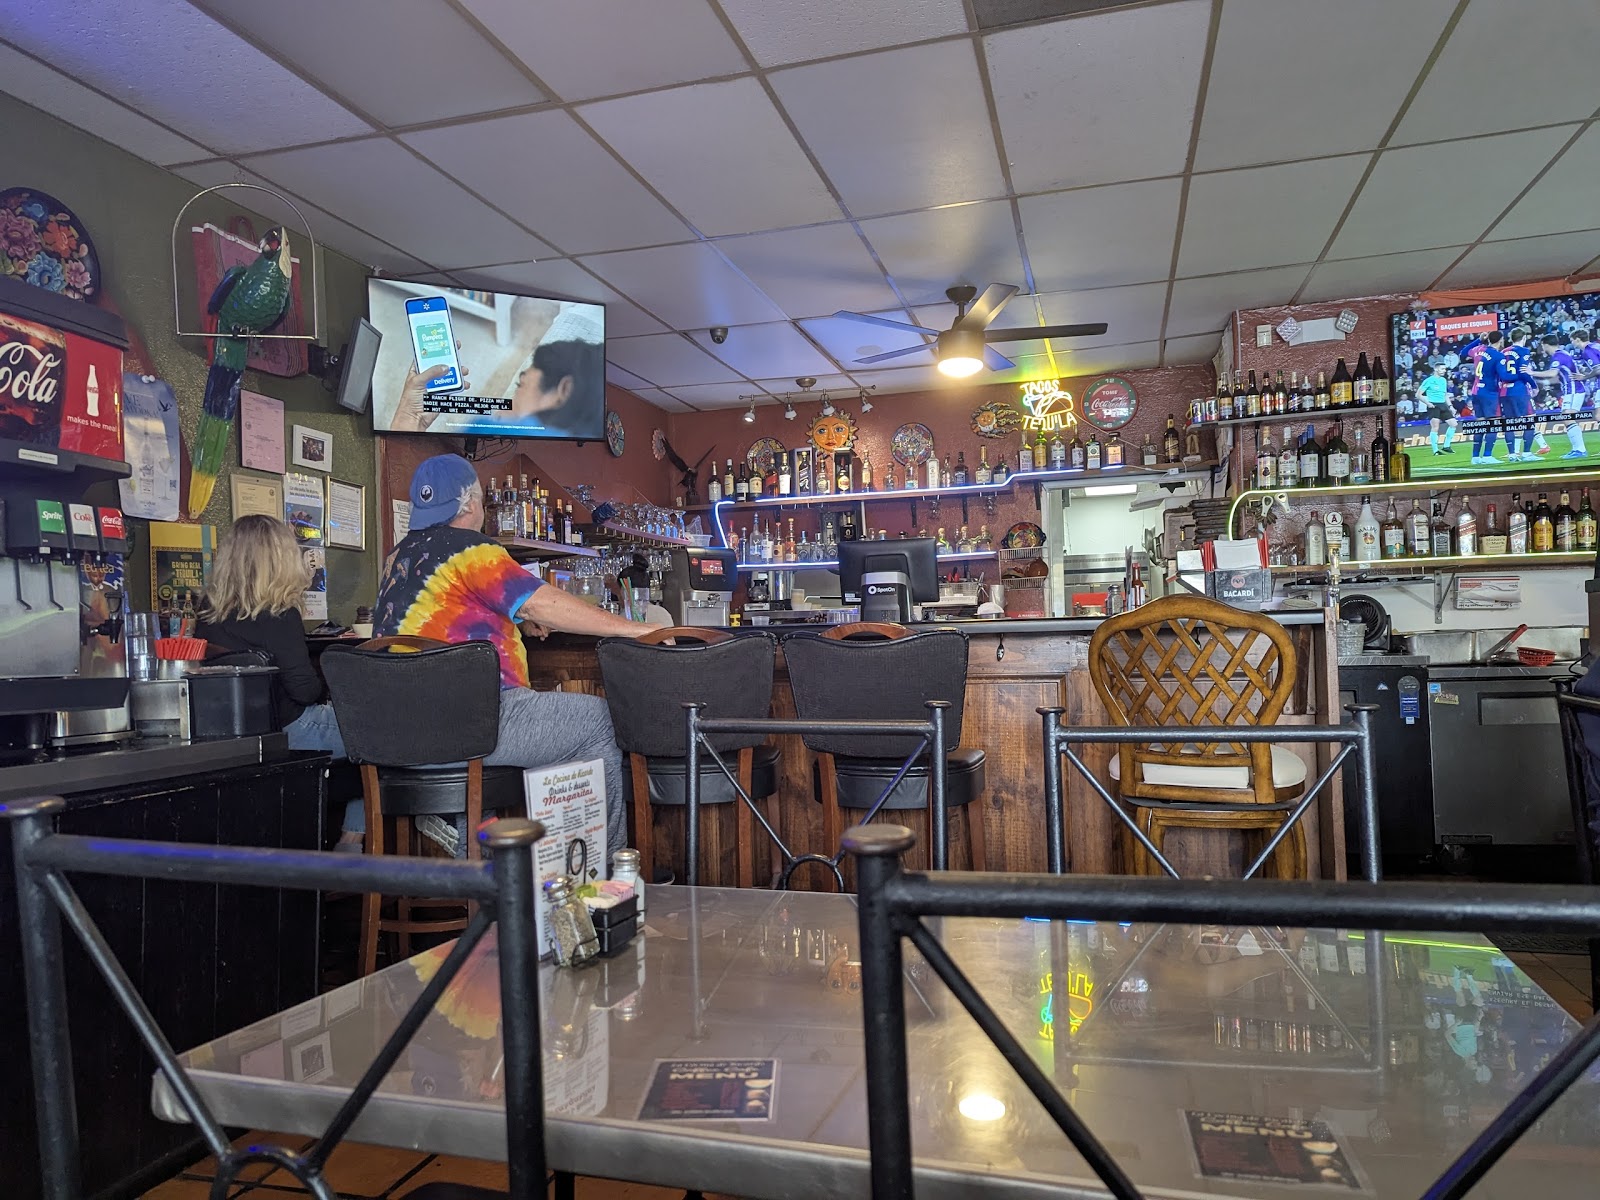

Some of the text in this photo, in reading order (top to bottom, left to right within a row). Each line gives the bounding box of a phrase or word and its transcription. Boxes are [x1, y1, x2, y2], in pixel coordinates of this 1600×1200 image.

[1440, 323, 1461, 331] SAQUES
[1469, 320, 1493, 328] ESQUINA
[422, 333, 443, 342] Pampers
[434, 377, 455, 386] Delivery
[1020, 379, 1060, 395] TACOS
[67, 415, 89, 426] makes
[90, 418, 101, 428] the
[1022, 412, 1077, 431] TEQUILA
[1462, 420, 1491, 428] ASEGURA
[1506, 416, 1535, 424] DESPEJE
[1463, 427, 1487, 435] ENVIAR
[1490, 425, 1503, 433] ESE
[1506, 423, 1526, 432] BALÓN
[42, 511, 62, 521] Sprite
[74, 512, 93, 521] Coke
[1331, 514, 1338, 523] A
[175, 569, 199, 578] TEQUILA
[877, 586, 896, 594] SpotOn
[1223, 588, 1255, 597] BACARDÍ
[543, 788, 593, 806] Margaritas
[670, 1072, 758, 1080] MENU
[1201, 1123, 1313, 1139] MENU
